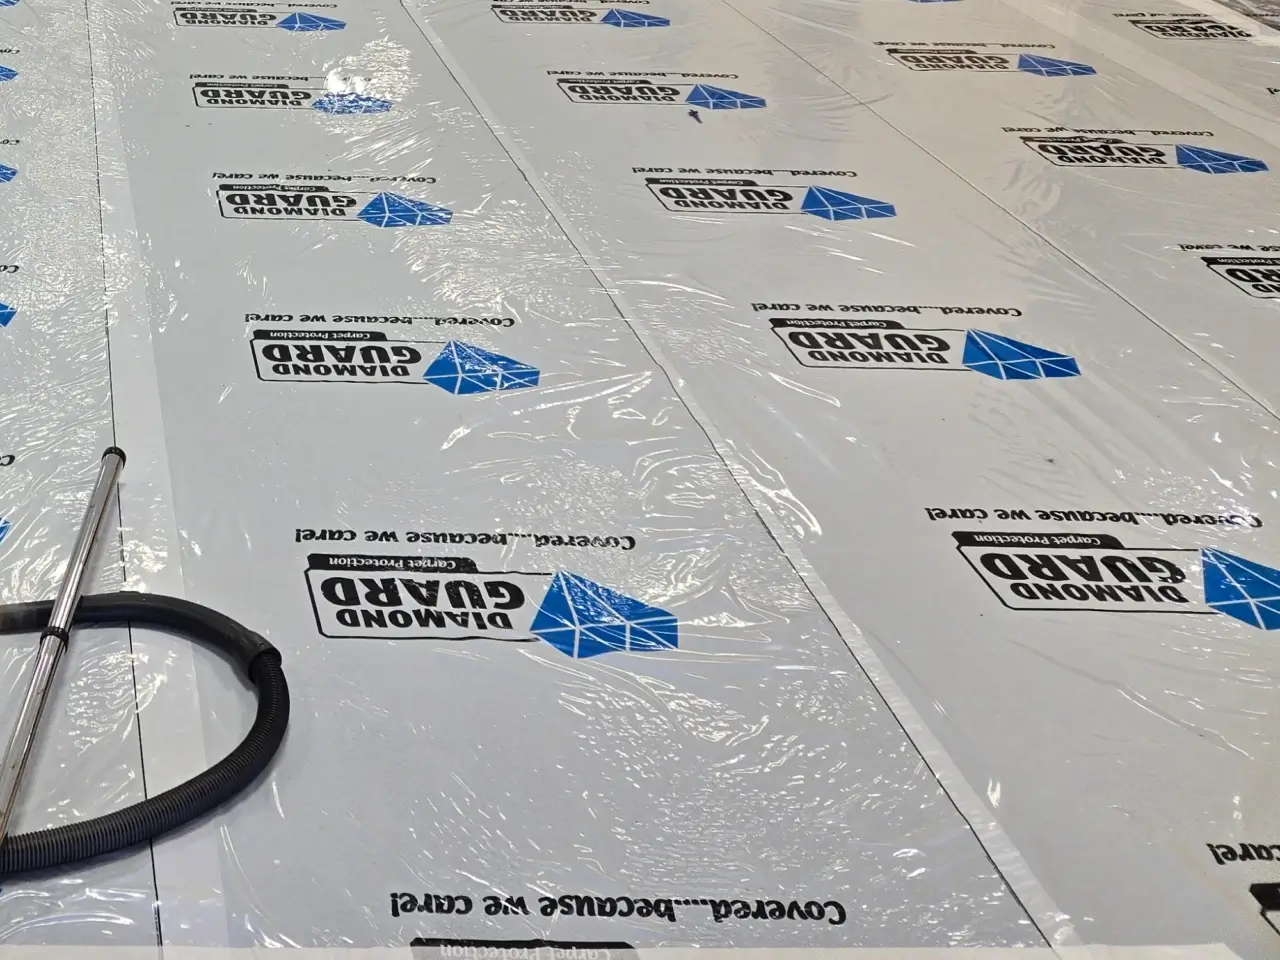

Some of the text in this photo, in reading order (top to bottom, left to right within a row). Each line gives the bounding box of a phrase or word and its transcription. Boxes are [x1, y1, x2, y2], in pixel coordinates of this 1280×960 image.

[180, 12, 277, 20] GUARD
[899, 55, 1010, 64] GUARD
[200, 89, 311, 100] GUARD
[567, 85, 680, 96] GUARD
[1037, 144, 1166, 158] GUARD
[1057, 156, 1167, 164] DIAMOND
[226, 193, 357, 208] GUARD
[659, 187, 793, 202] GUARD
[674, 200, 790, 209] DIAMOND
[233, 207, 346, 216] DIAMOND
[751, 302, 801, 312] care!
[805, 303, 835, 312] we
[244, 313, 294, 323] care!
[299, 314, 326, 322] we
[786, 319, 886, 328] Carpet Protection
[270, 331, 370, 339] Carpet Protection
[787, 331, 950, 351] GUARD
[262, 344, 421, 364] GUARD
[808, 350, 949, 364] DIAMOND
[272, 364, 410, 376] DIAMOND
[924, 507, 989, 521] care!
[993, 509, 1032, 521] we
[295, 529, 357, 543] care!
[363, 531, 399, 543] we
[974, 534, 1100, 546] Carpet Protection
[329, 557, 456, 570] Carpet Protection
[980, 553, 1186, 583] GUARD
[320, 577, 525, 610] GUARD
[1010, 582, 1189, 603] DIAMOND
[335, 609, 513, 629] DIAMOND
[390, 892, 472, 919] care!
[482, 895, 530, 919] we
